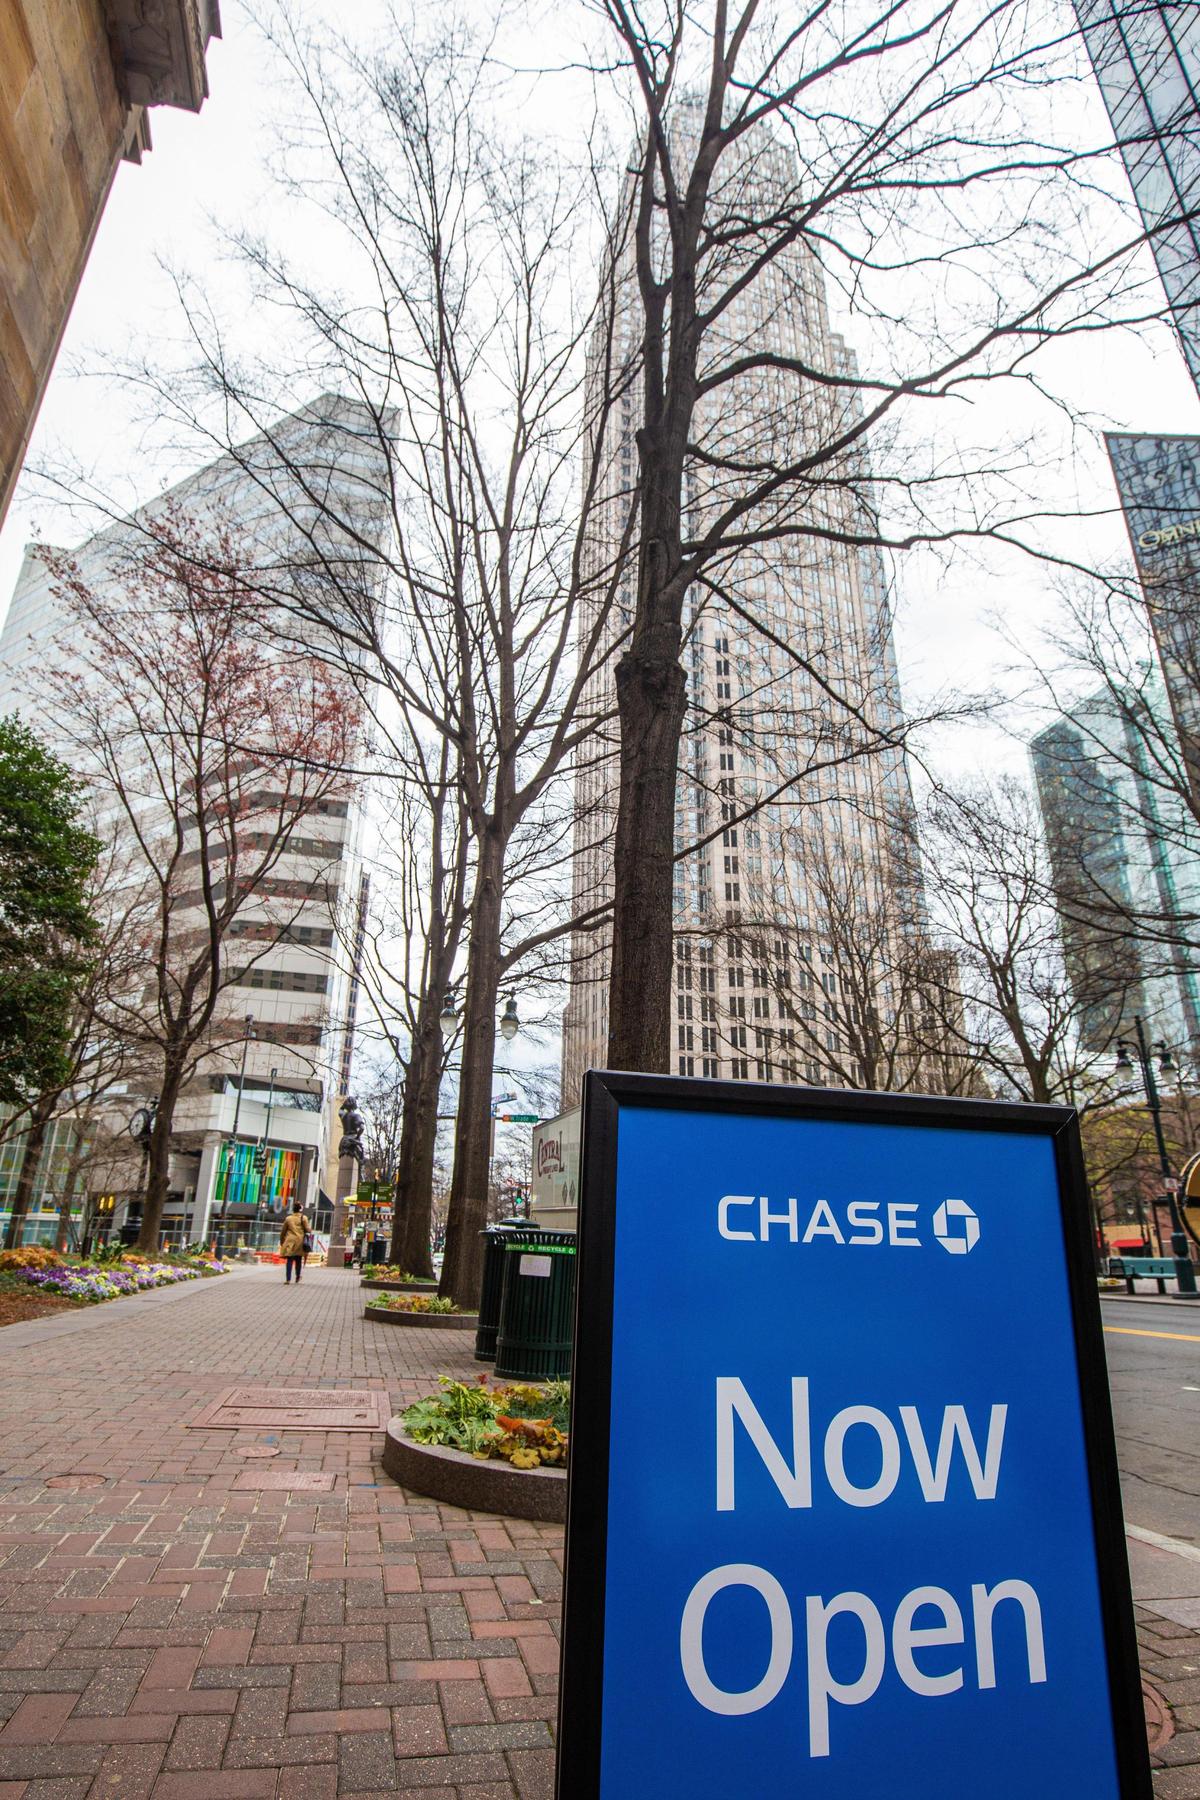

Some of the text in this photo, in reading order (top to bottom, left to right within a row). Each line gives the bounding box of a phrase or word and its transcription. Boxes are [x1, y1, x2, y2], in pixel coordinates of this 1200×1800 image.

[538, 1131, 565, 1177] CENTRAL
[718, 1196, 921, 1246] CHASE
[717, 1377, 1007, 1511] Now
[681, 1564, 1046, 1757] Open
